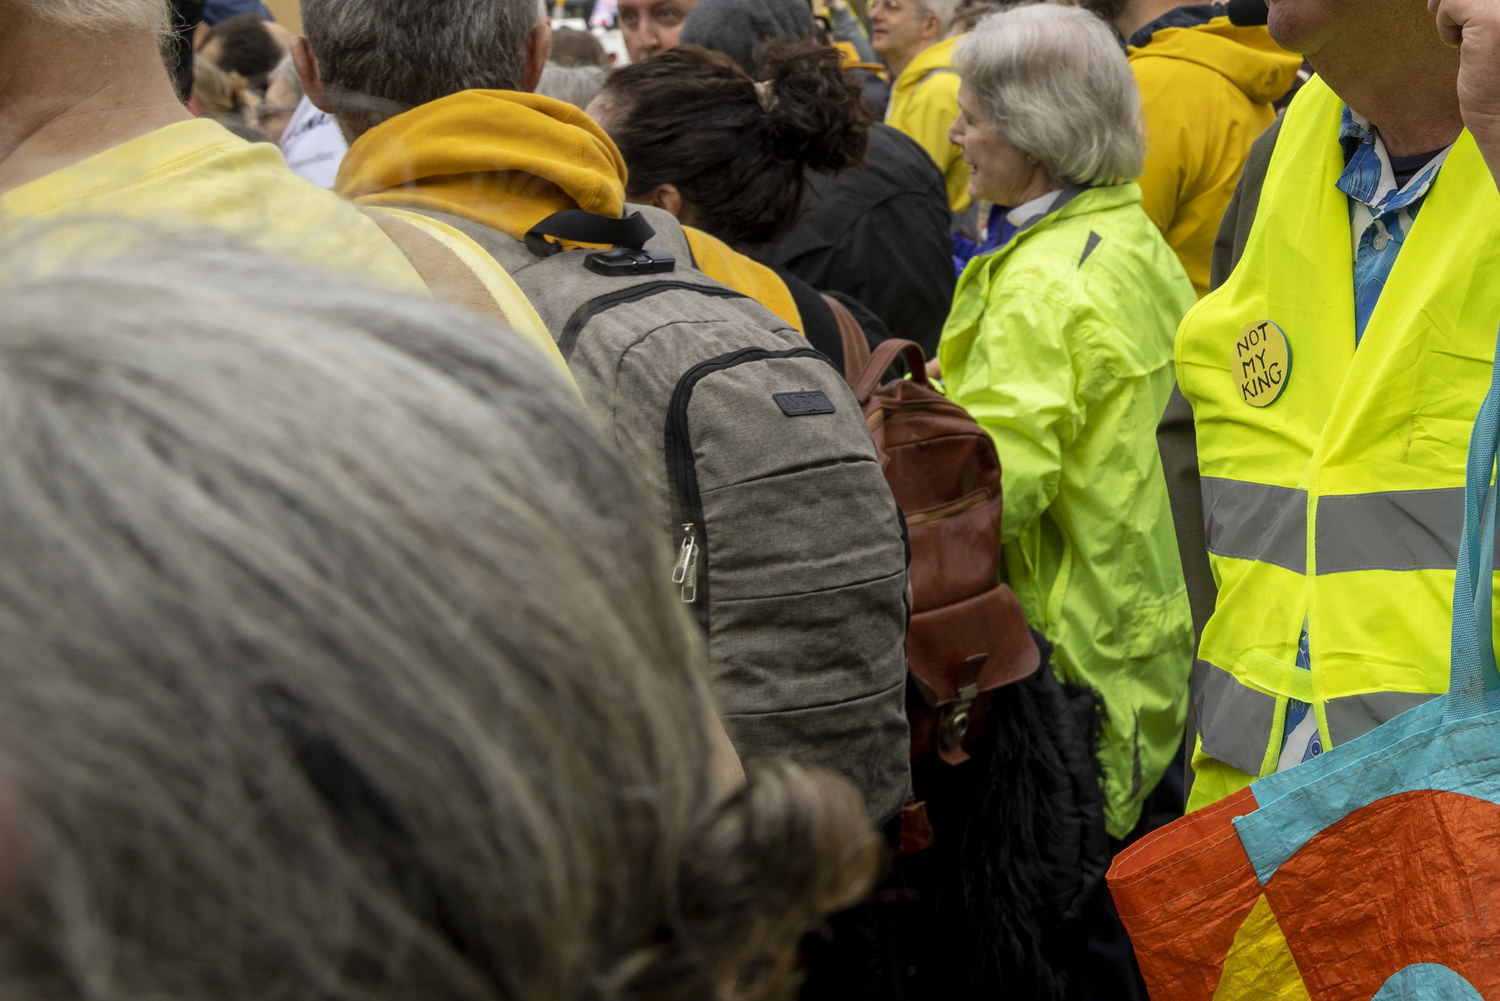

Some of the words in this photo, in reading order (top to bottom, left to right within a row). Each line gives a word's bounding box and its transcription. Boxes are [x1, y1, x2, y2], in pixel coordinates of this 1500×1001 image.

[1236, 322, 1269, 357] NOT
[1242, 348, 1266, 379] MY
[1241, 362, 1282, 401] KING
